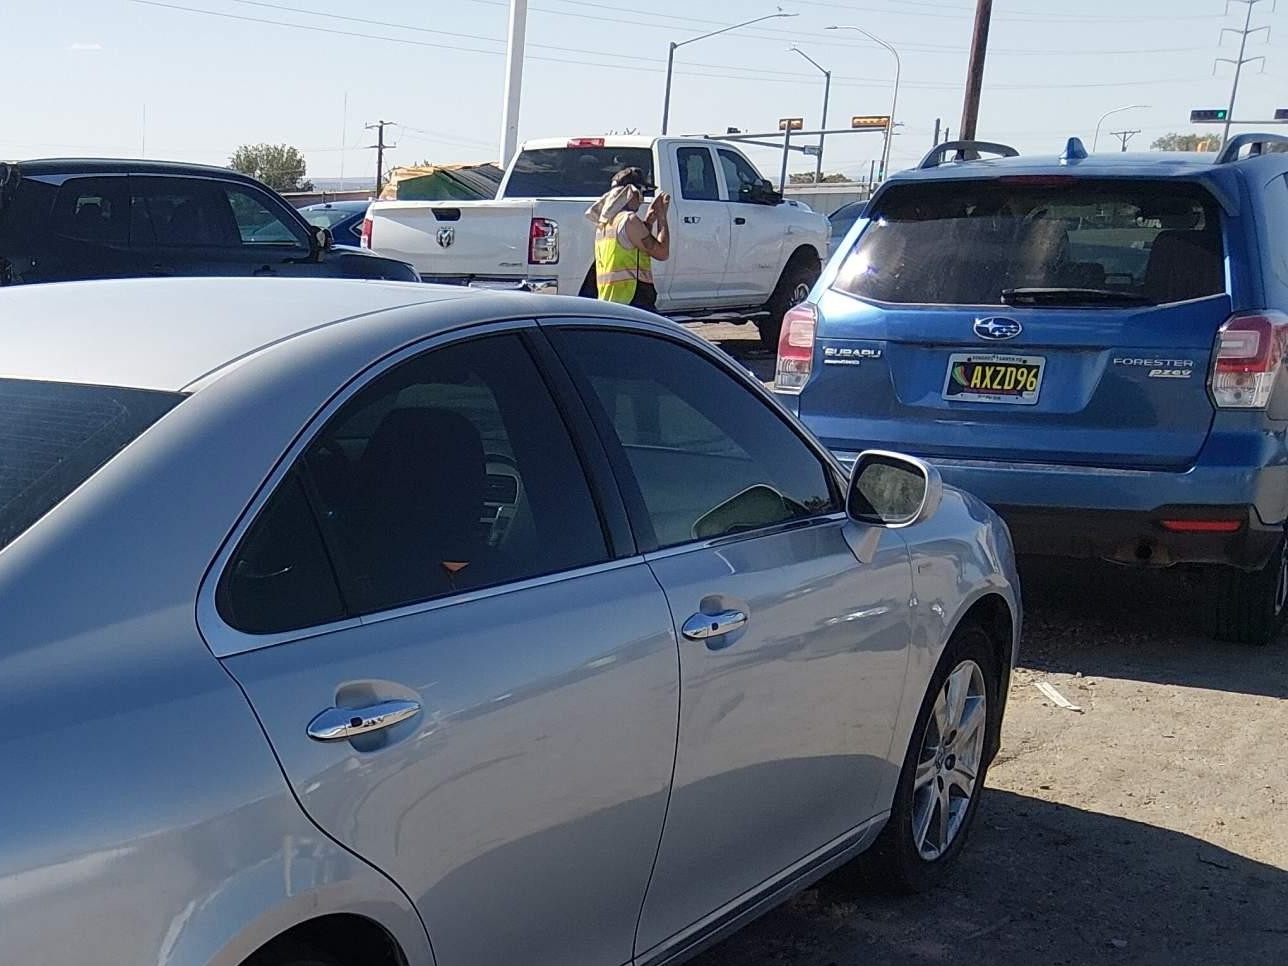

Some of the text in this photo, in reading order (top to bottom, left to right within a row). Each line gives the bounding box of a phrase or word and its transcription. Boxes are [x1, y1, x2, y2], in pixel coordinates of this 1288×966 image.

[823, 346, 882, 358] SUBARU
[1113, 358, 1193, 367] FORESTER
[970, 365, 1038, 391] AXZD96
